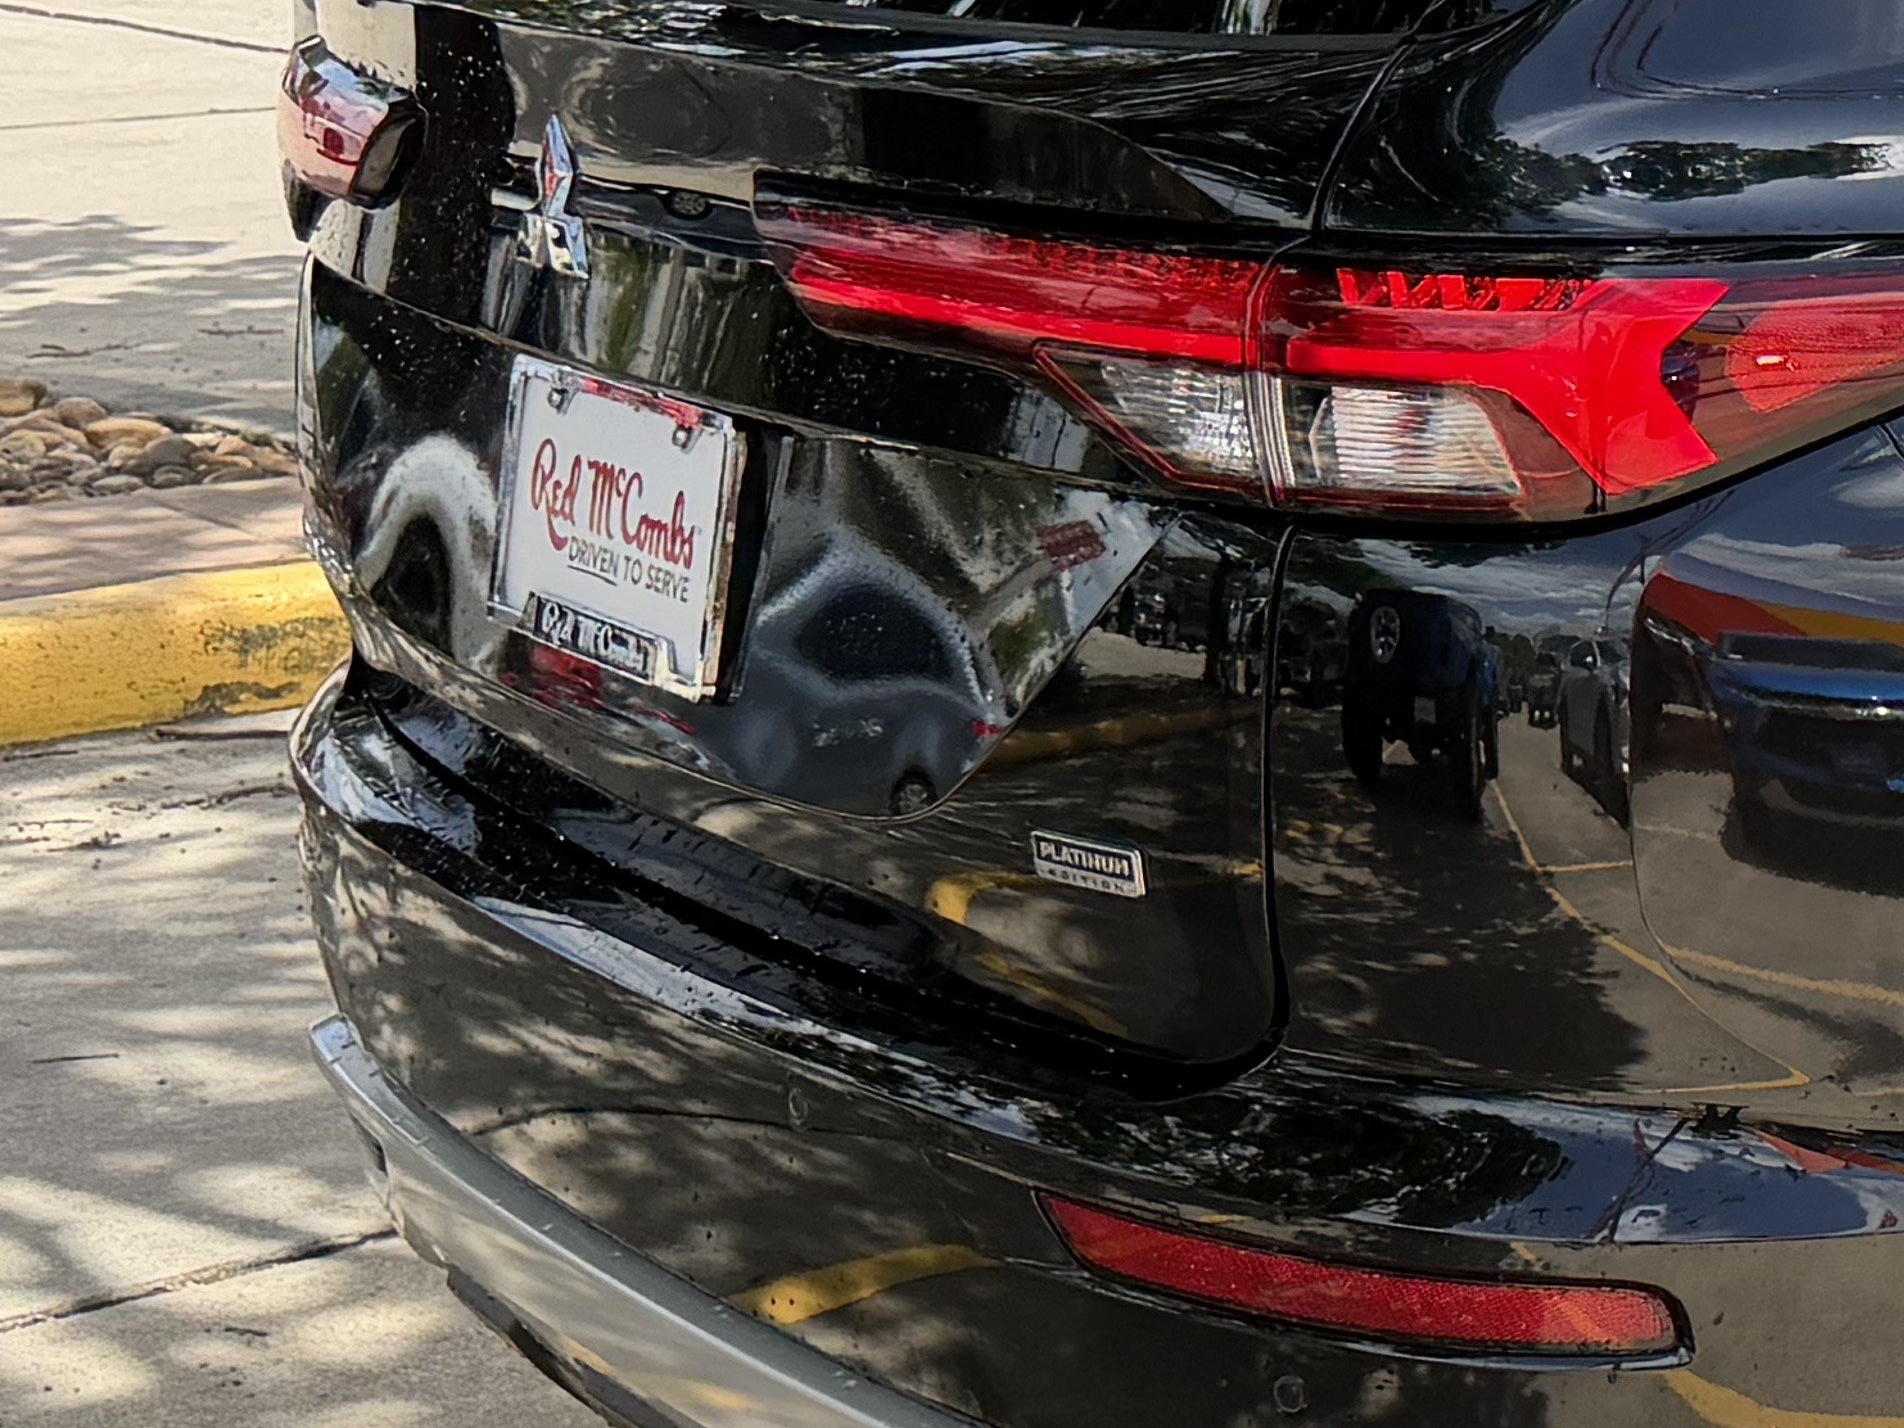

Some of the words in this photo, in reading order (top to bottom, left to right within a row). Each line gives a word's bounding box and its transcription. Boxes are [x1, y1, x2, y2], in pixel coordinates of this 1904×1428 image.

[531, 438, 582, 550] Red
[588, 459, 695, 570] McCombs
[568, 536, 620, 578] DRIVEN
[623, 555, 643, 585] TO
[645, 564, 690, 603] SERVE
[1039, 840, 1130, 877] PLATINUM
